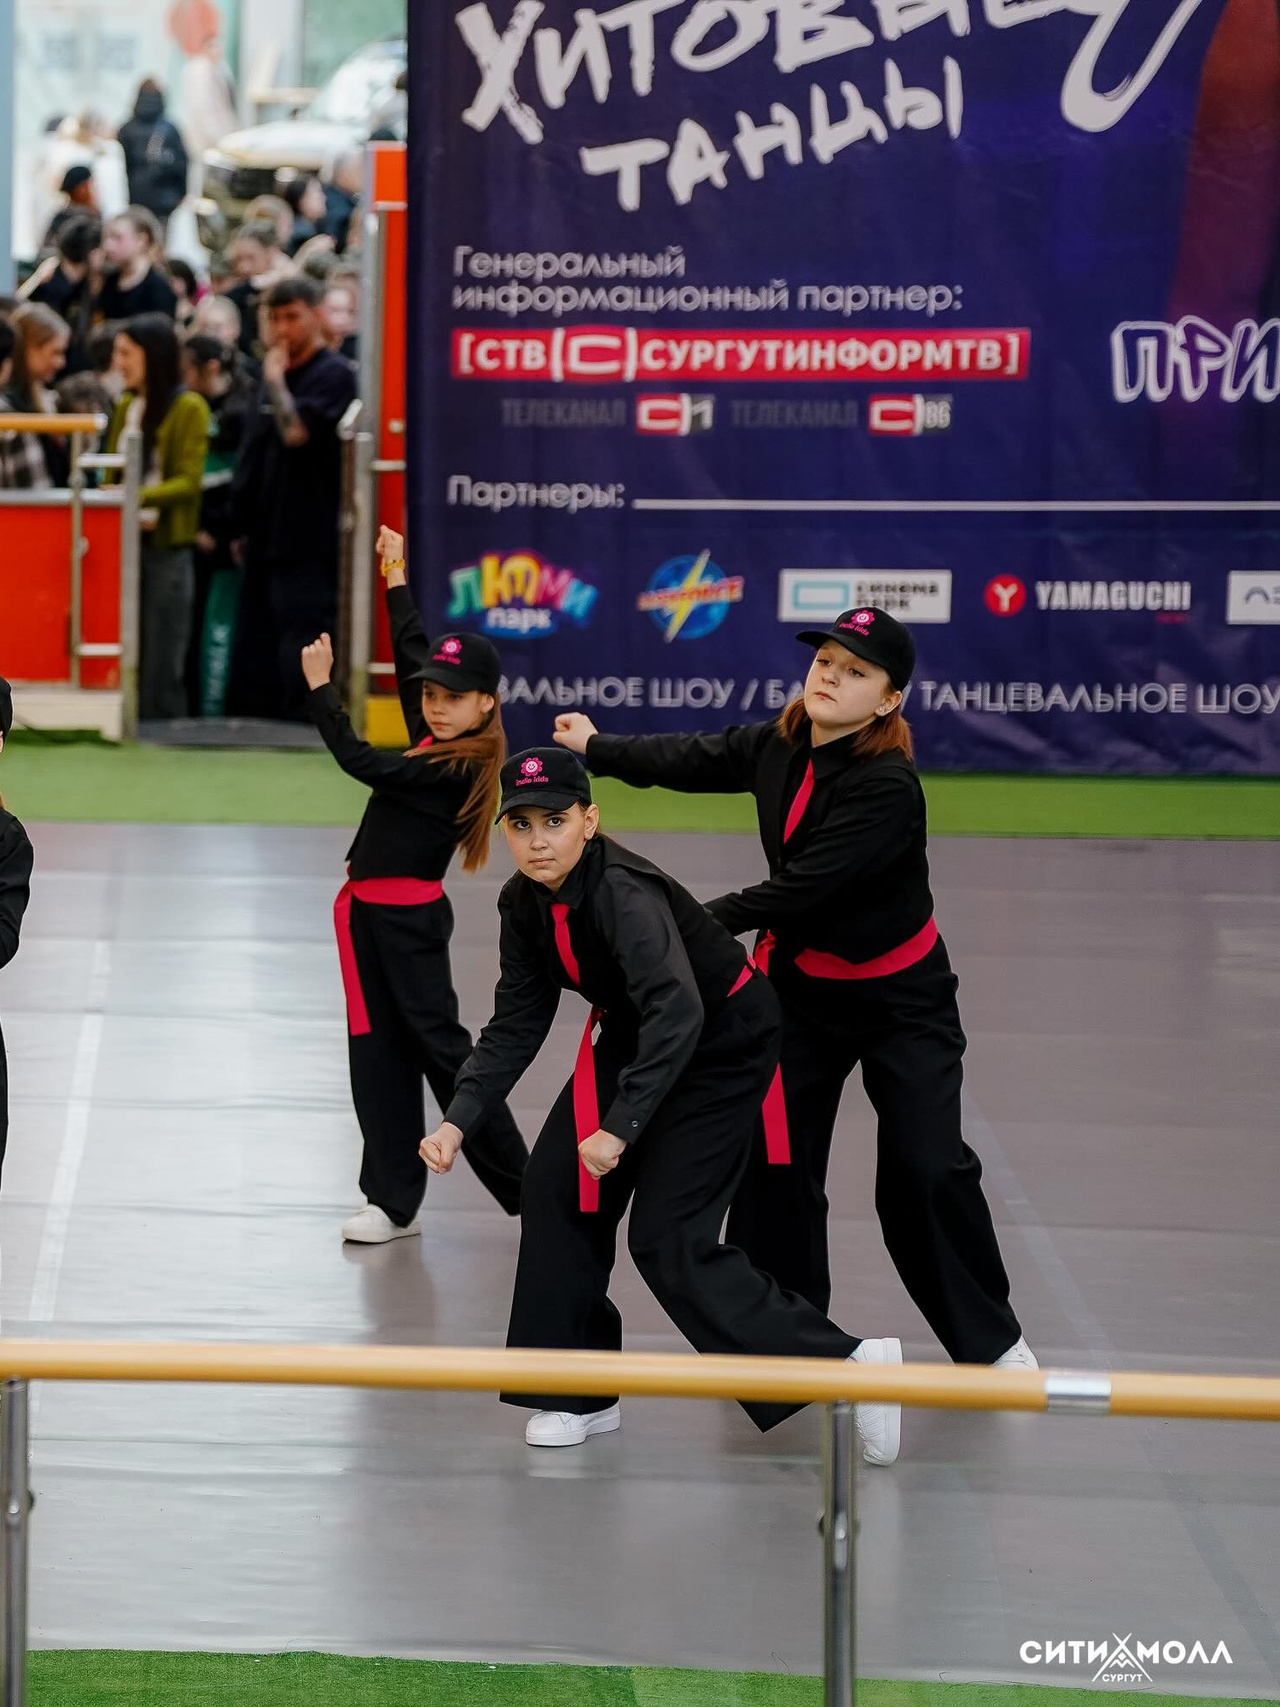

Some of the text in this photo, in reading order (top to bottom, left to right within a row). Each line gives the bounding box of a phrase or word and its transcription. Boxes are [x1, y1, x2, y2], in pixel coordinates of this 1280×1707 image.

[580, 56, 963, 210] ТАНЦЫ
[453, 246, 686, 283] Генеральный
[453, 279, 963, 318] информационный партнер:
[447, 474, 625, 514] Партнеры:
[448, 555, 597, 618] ЛЮМИ
[1035, 581, 1192, 611] YAMAGUCHI
[649, 677, 735, 708] ШОУ
[920, 681, 1187, 713] ТАНЦЕВАЛЬНОЕ
